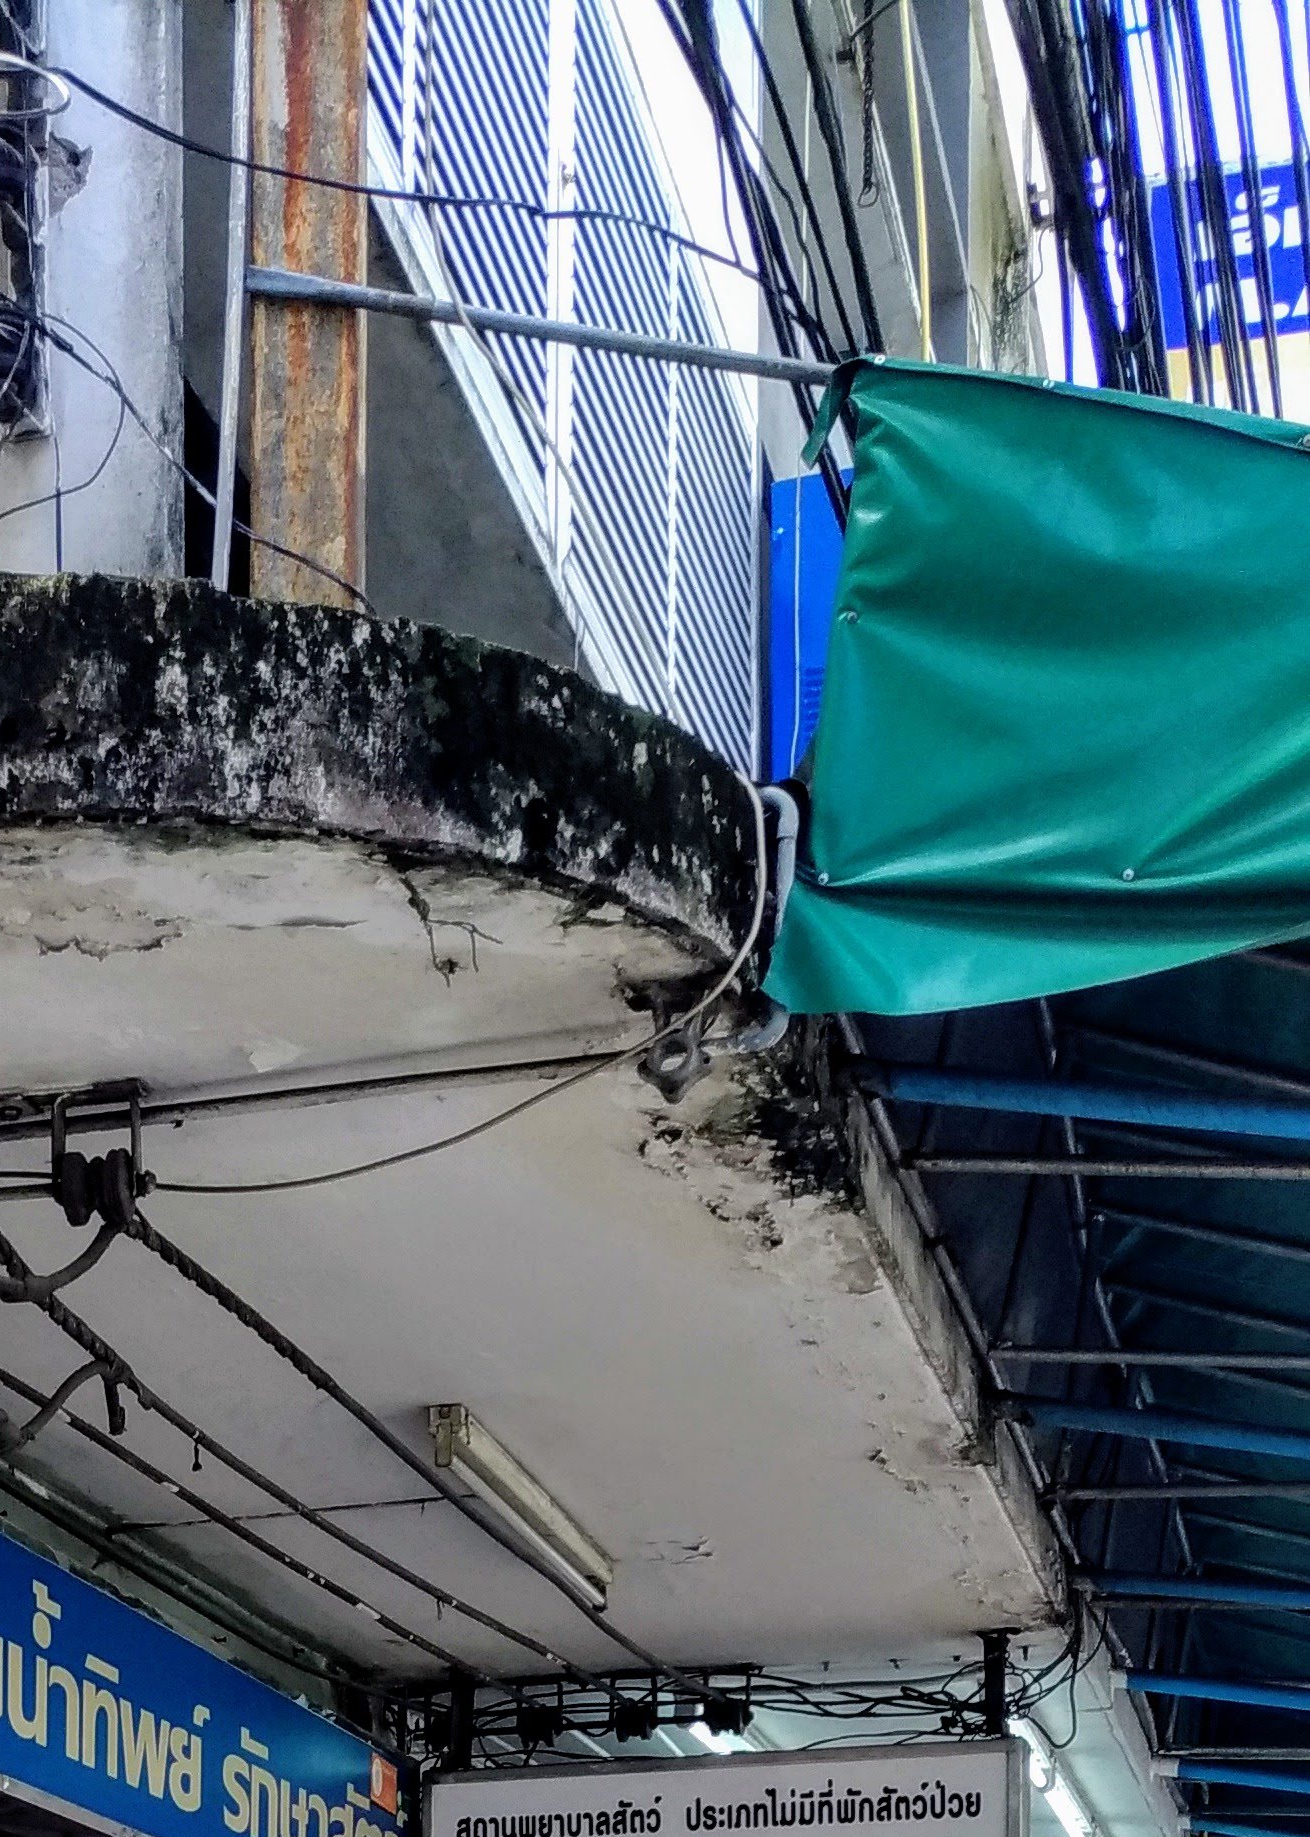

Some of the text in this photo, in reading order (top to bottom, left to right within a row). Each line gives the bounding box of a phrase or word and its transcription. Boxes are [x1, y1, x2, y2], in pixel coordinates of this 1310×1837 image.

[685, 1779, 982, 1832] ประเภทไม่มีที่พักสัตว์ป่วย
